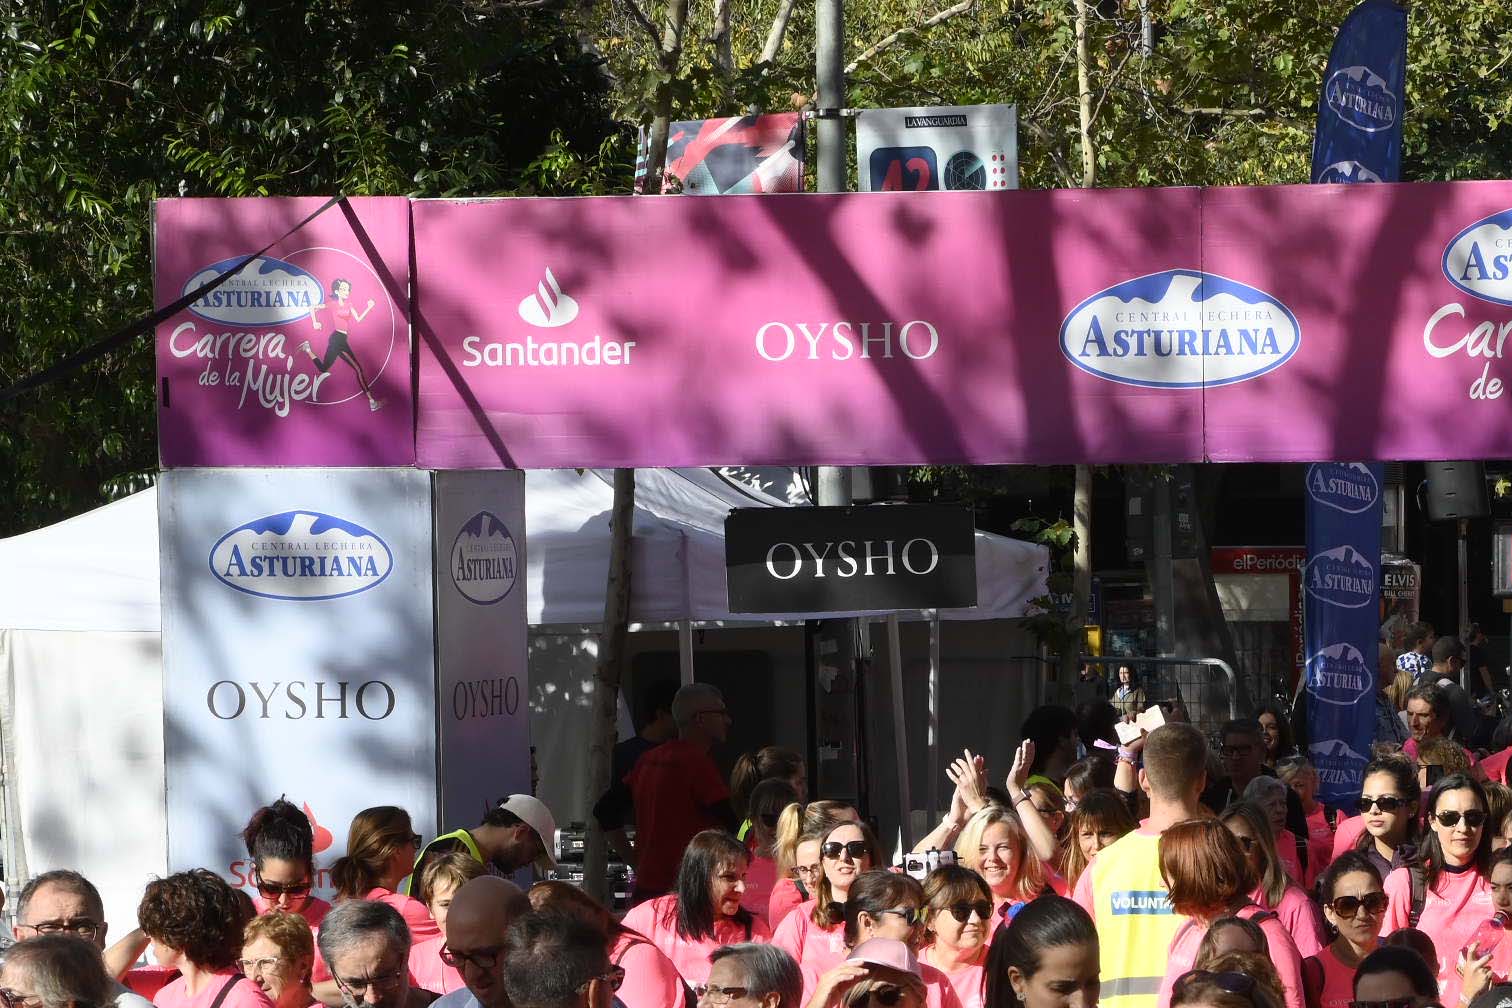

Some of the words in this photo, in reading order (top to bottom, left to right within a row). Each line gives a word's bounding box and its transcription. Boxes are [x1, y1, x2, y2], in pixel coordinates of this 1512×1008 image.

[193, 287, 311, 309] ASTURIANA
[219, 279, 258, 289] ENTRAL
[1116, 310, 1191, 323] CENTRAL
[169, 322, 287, 359] Carrera
[462, 336, 636, 367] Santander
[755, 320, 939, 361] OYSHO
[1079, 315, 1281, 358] ASTURIANA
[199, 361, 221, 386] de
[225, 360, 241, 386] la
[237, 356, 331, 417] Mujer
[1469, 360, 1503, 400] de
[1311, 467, 1372, 502] ASTURIANA
[223, 544, 380, 579] ASTURIANA
[251, 541, 312, 551] CENTRAL
[315, 541, 373, 551] LECHERA
[766, 538, 939, 579] OYSHO
[456, 547, 514, 582] ASTURIANA
[1310, 565, 1373, 595] ASTURIANA
[1384, 574, 1416, 587] ELVIS
[207, 680, 396, 720] OYSHO
[453, 677, 519, 720] OYSHO
